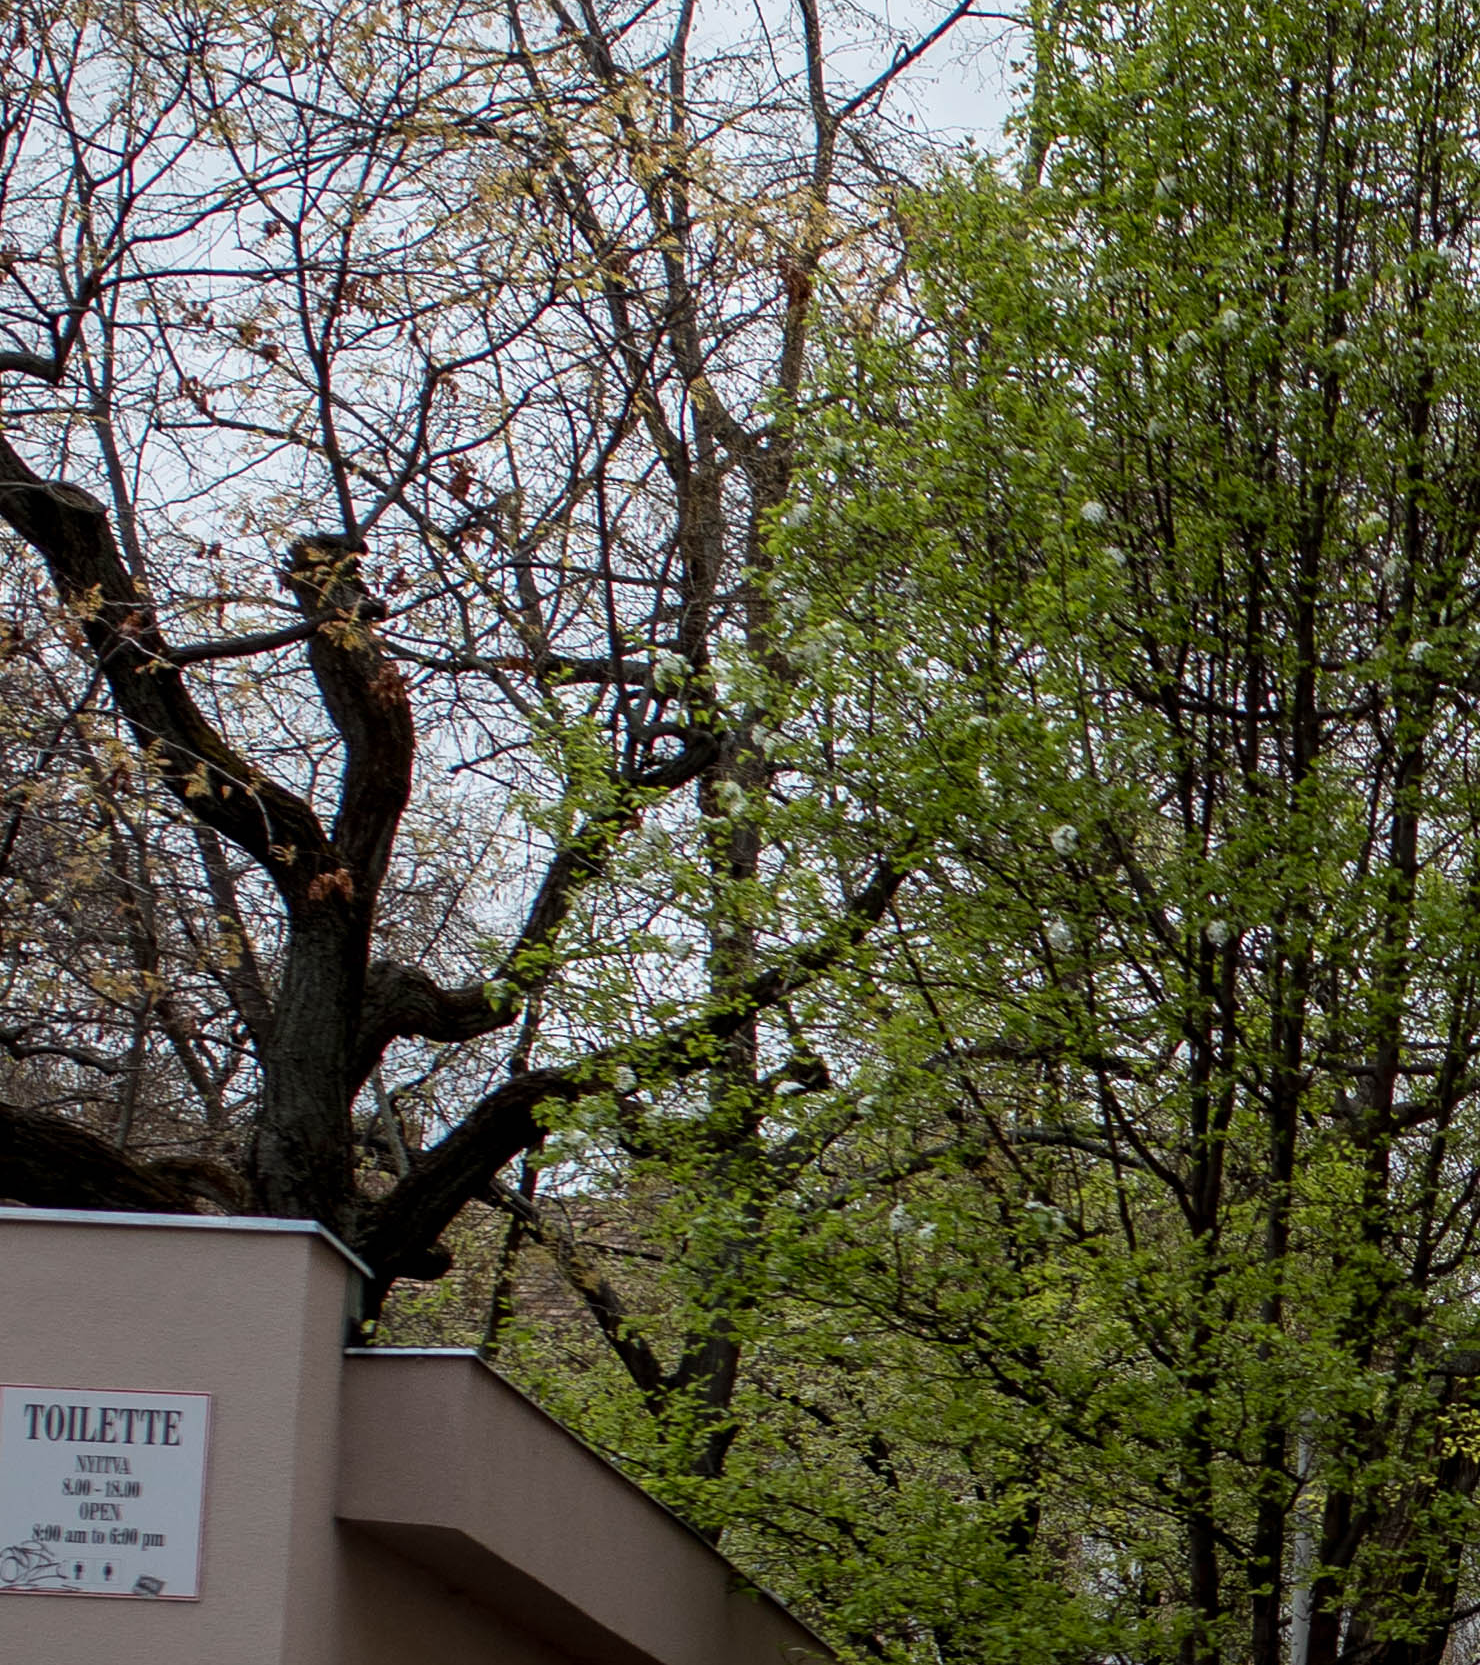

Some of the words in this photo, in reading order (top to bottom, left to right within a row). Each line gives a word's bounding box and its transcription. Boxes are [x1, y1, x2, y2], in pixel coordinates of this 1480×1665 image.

[24, 1403, 184, 1447] TOILETTE
[76, 1454, 132, 1475] NYITVA
[62, 1478, 91, 1496] 8.00
[104, 1480, 141, 1498] 18.00
[79, 1502, 123, 1521] OPEN
[32, 1524, 61, 1542] 8:00
[64, 1529, 87, 1544] am
[91, 1527, 105, 1544] to
[142, 1532, 165, 1551] pm
